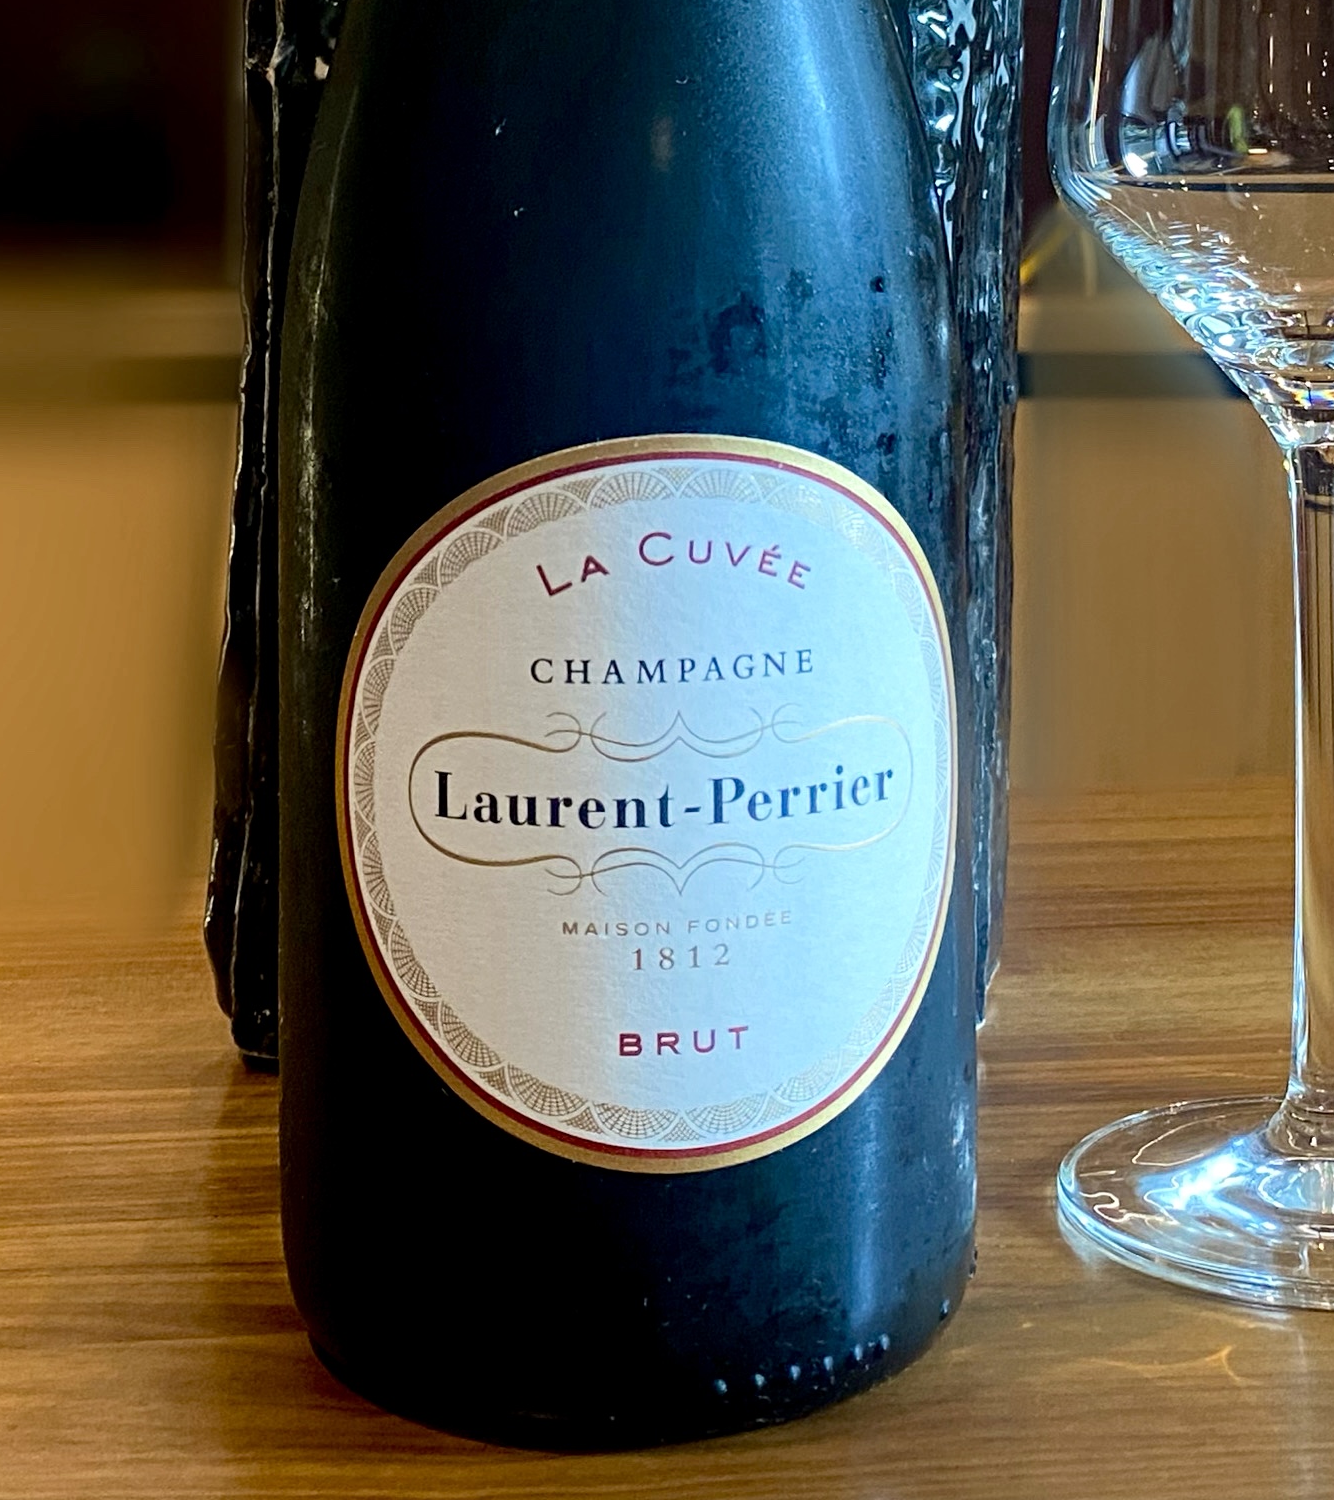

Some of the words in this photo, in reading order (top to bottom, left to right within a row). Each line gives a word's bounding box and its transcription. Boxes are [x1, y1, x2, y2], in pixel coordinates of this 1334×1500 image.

[536, 555, 610, 597] LA
[638, 531, 811, 589] CUVÉE
[529, 648, 816, 685] CHAMPAGNE
[433, 763, 895, 830] Laurent-Perrier
[562, 921, 671, 937] MAISON
[632, 942, 731, 971] 1812
[618, 1026, 750, 1057] BRUT
